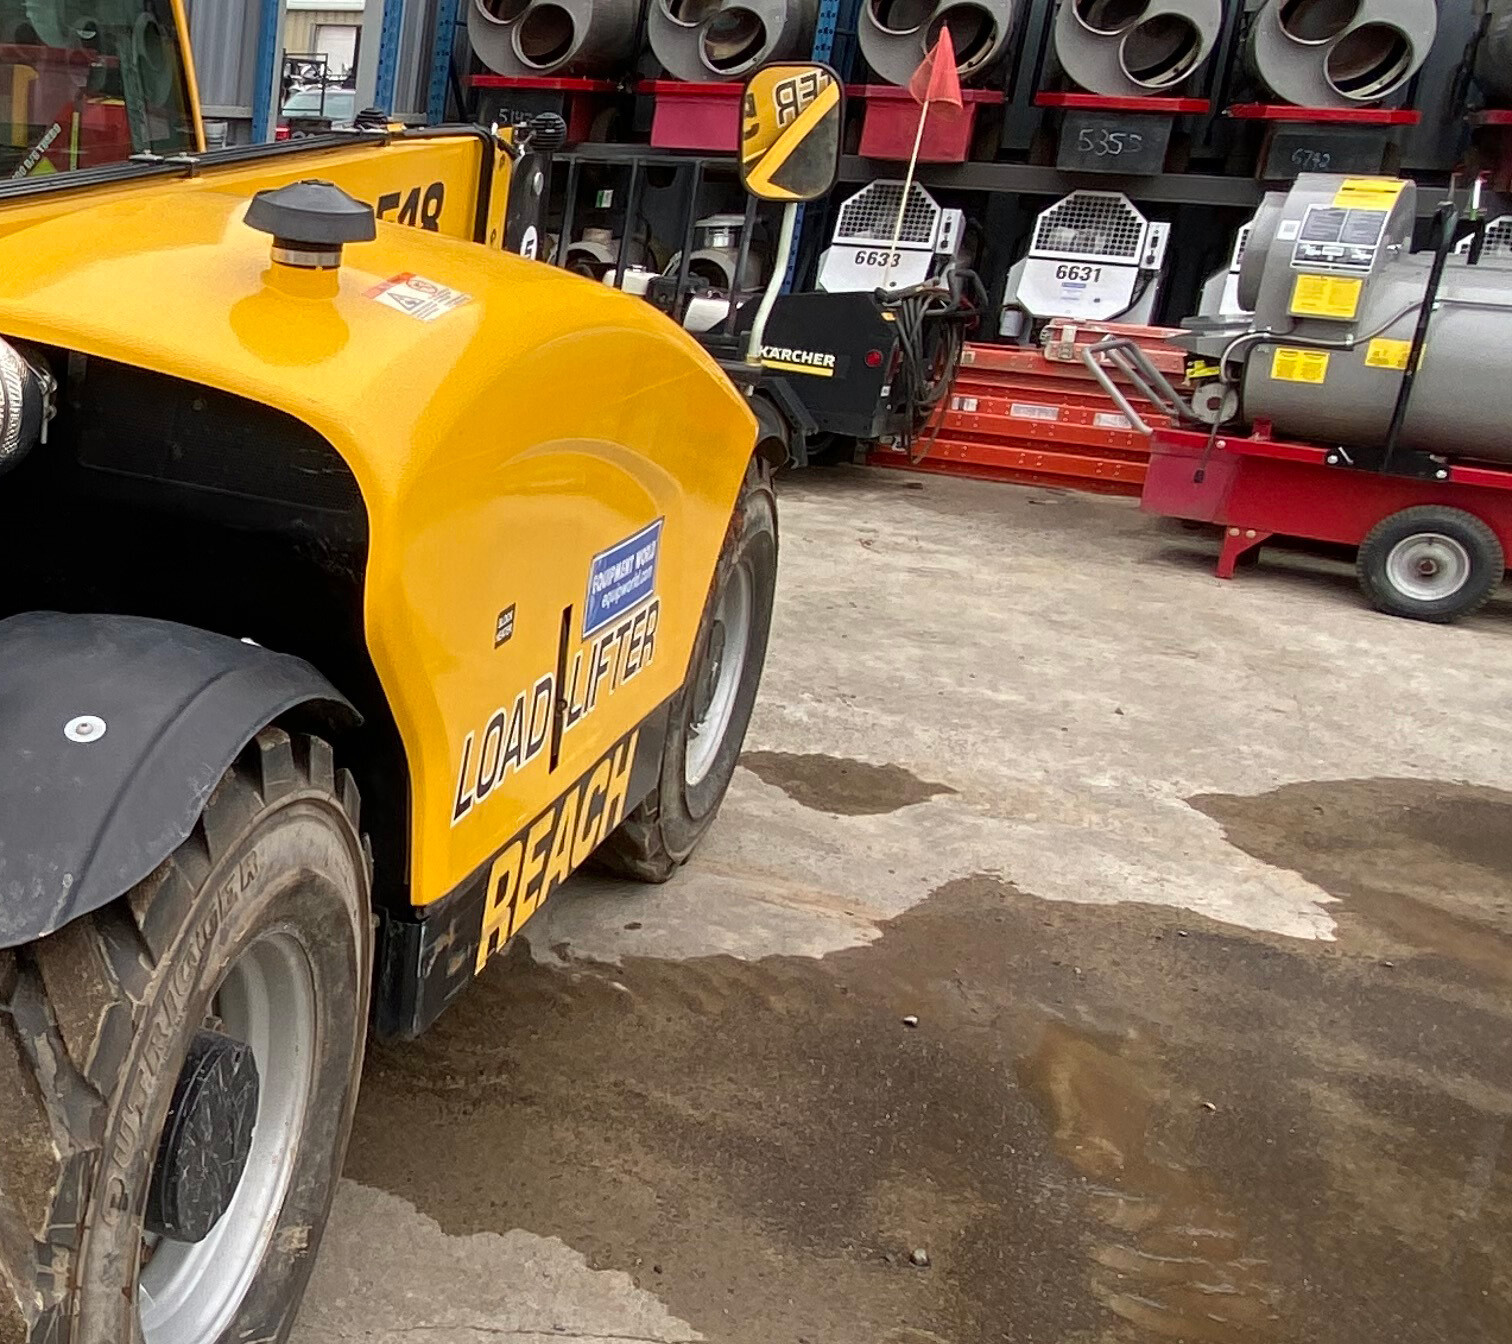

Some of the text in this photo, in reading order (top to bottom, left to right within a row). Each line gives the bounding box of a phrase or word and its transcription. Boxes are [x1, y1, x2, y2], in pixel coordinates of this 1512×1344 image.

[853, 249, 902, 269] 6633
[1055, 264, 1103, 284] 6631
[449, 595, 661, 830] LOAD LIFTER
[473, 726, 641, 977] REACH
